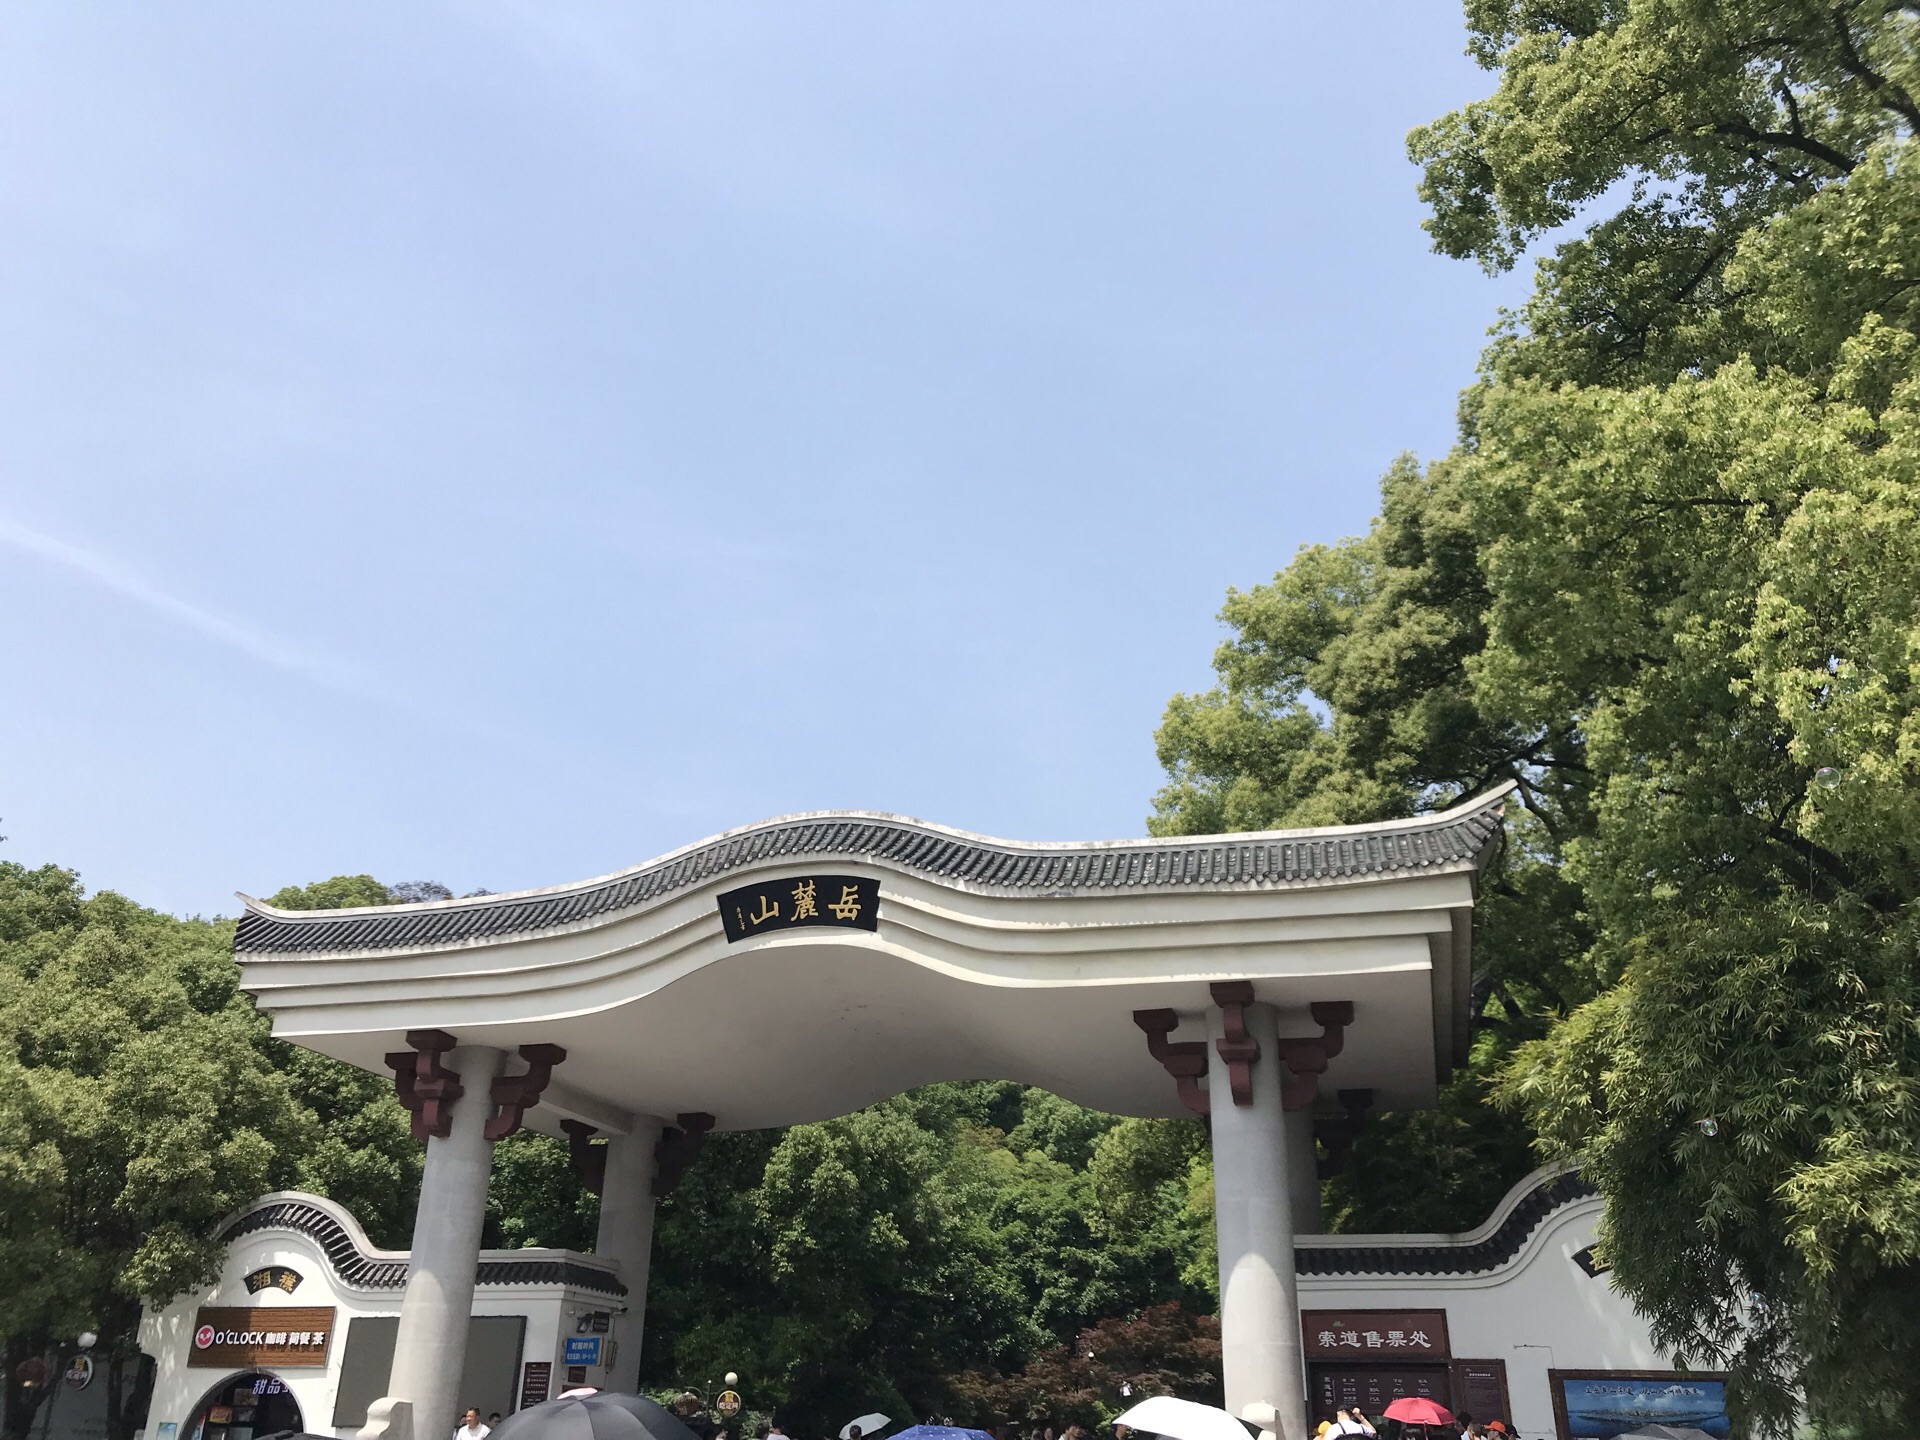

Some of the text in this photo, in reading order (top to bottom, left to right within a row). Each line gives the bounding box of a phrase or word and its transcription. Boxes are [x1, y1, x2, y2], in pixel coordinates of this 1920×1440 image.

[750, 879, 862, 925] 岳麓山
[266, 1332, 287, 1345] 咖啡
[312, 1332, 325, 1345] 茶
[1318, 1330, 1431, 1348] 索道售票处
